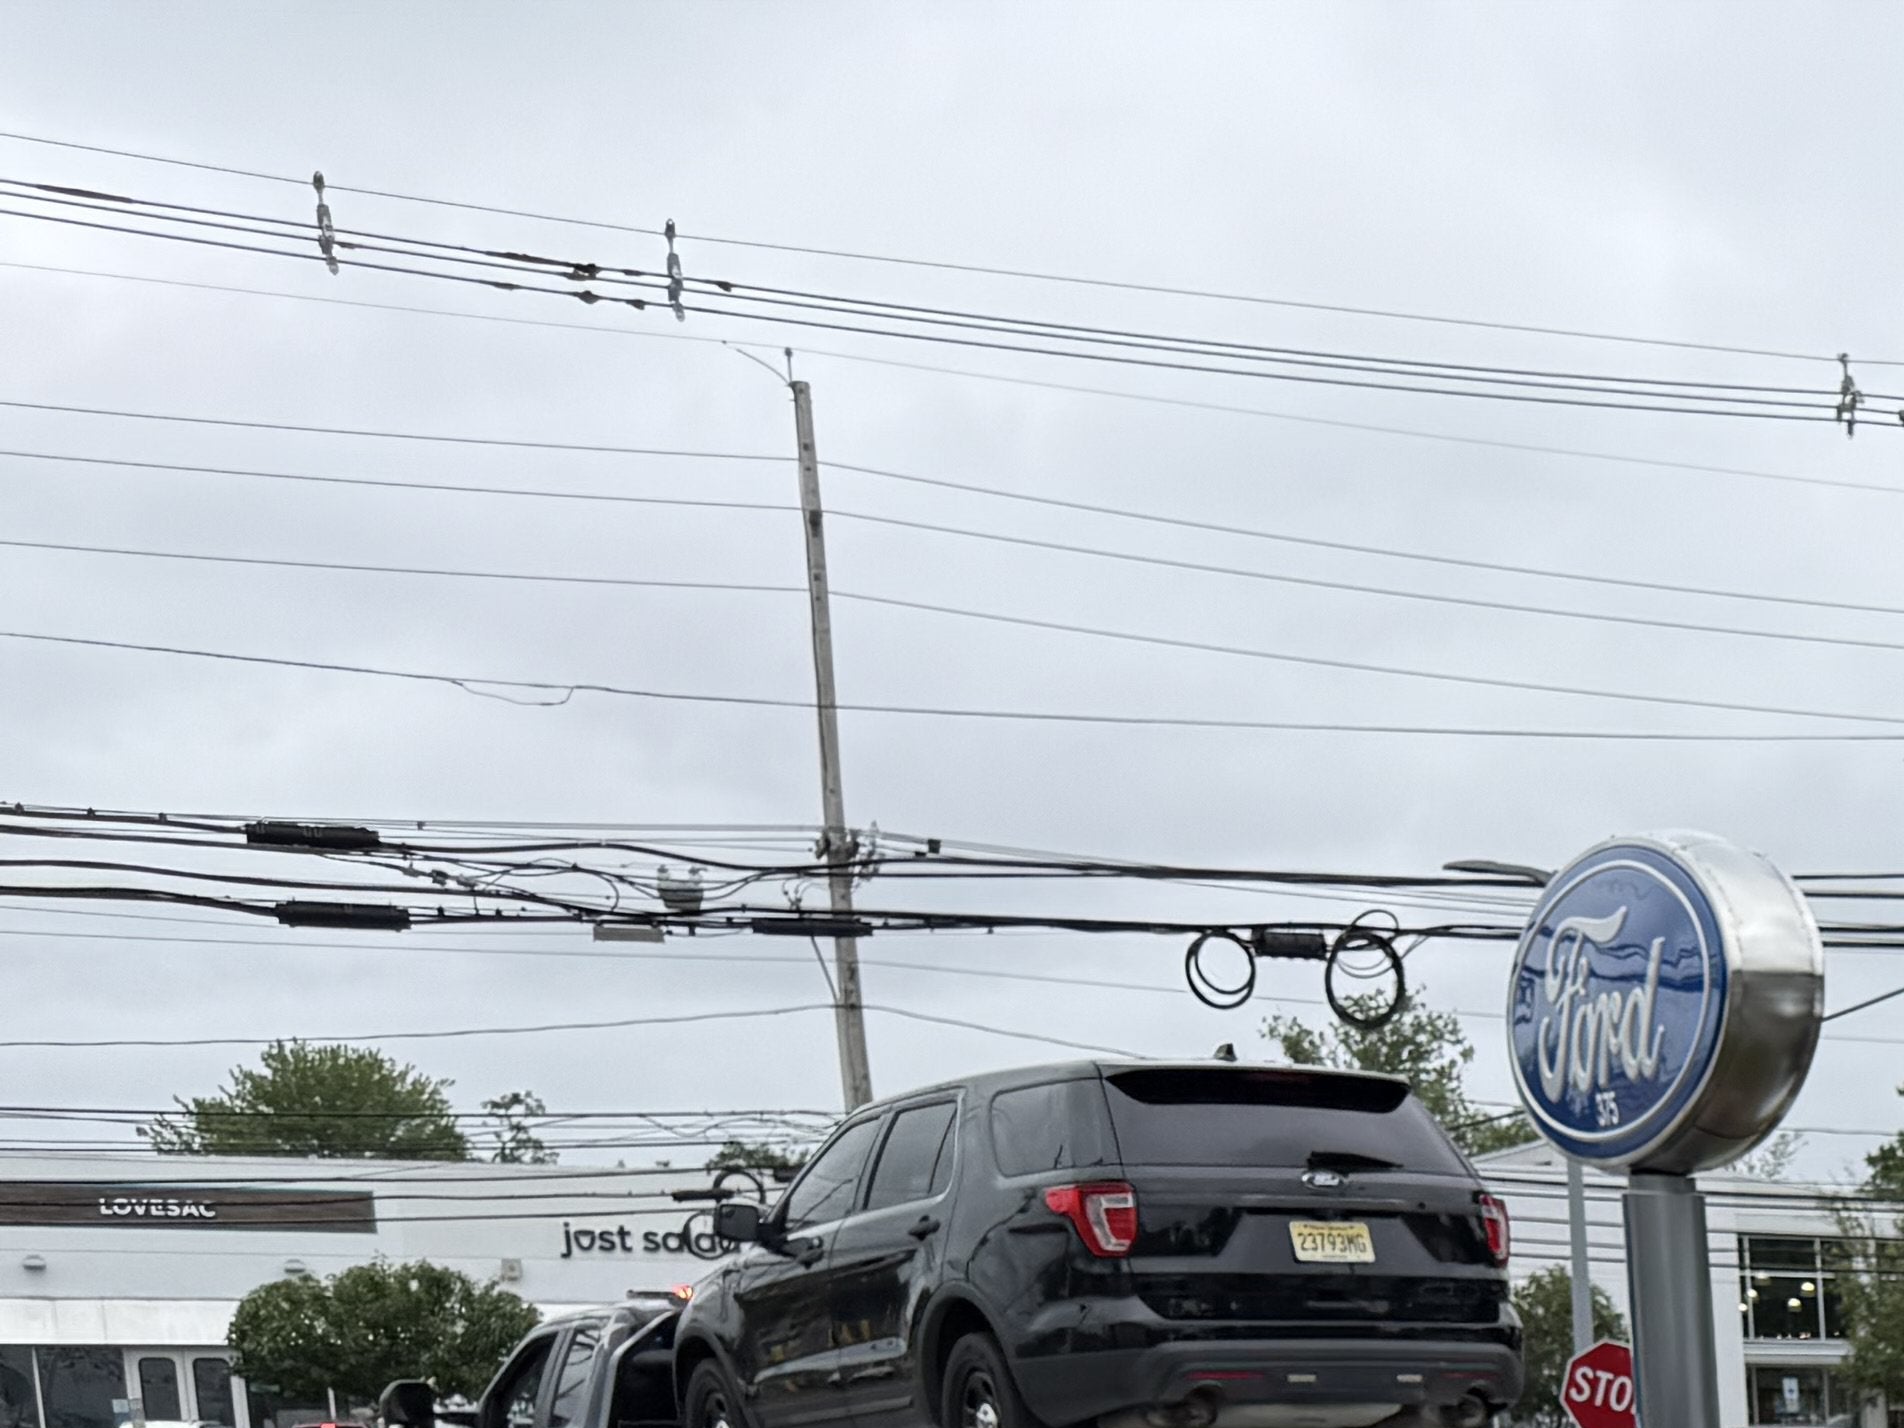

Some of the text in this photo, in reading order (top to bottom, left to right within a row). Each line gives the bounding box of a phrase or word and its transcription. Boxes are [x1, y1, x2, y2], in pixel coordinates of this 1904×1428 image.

[1539, 906, 1665, 1103] Ford
[1596, 1091, 1619, 1126] 375
[98, 1198, 216, 1217] LOVESAC
[561, 1222, 633, 1259] just
[1298, 1232, 1367, 1253] 23793MG
[1569, 1366, 1636, 1413] STO
